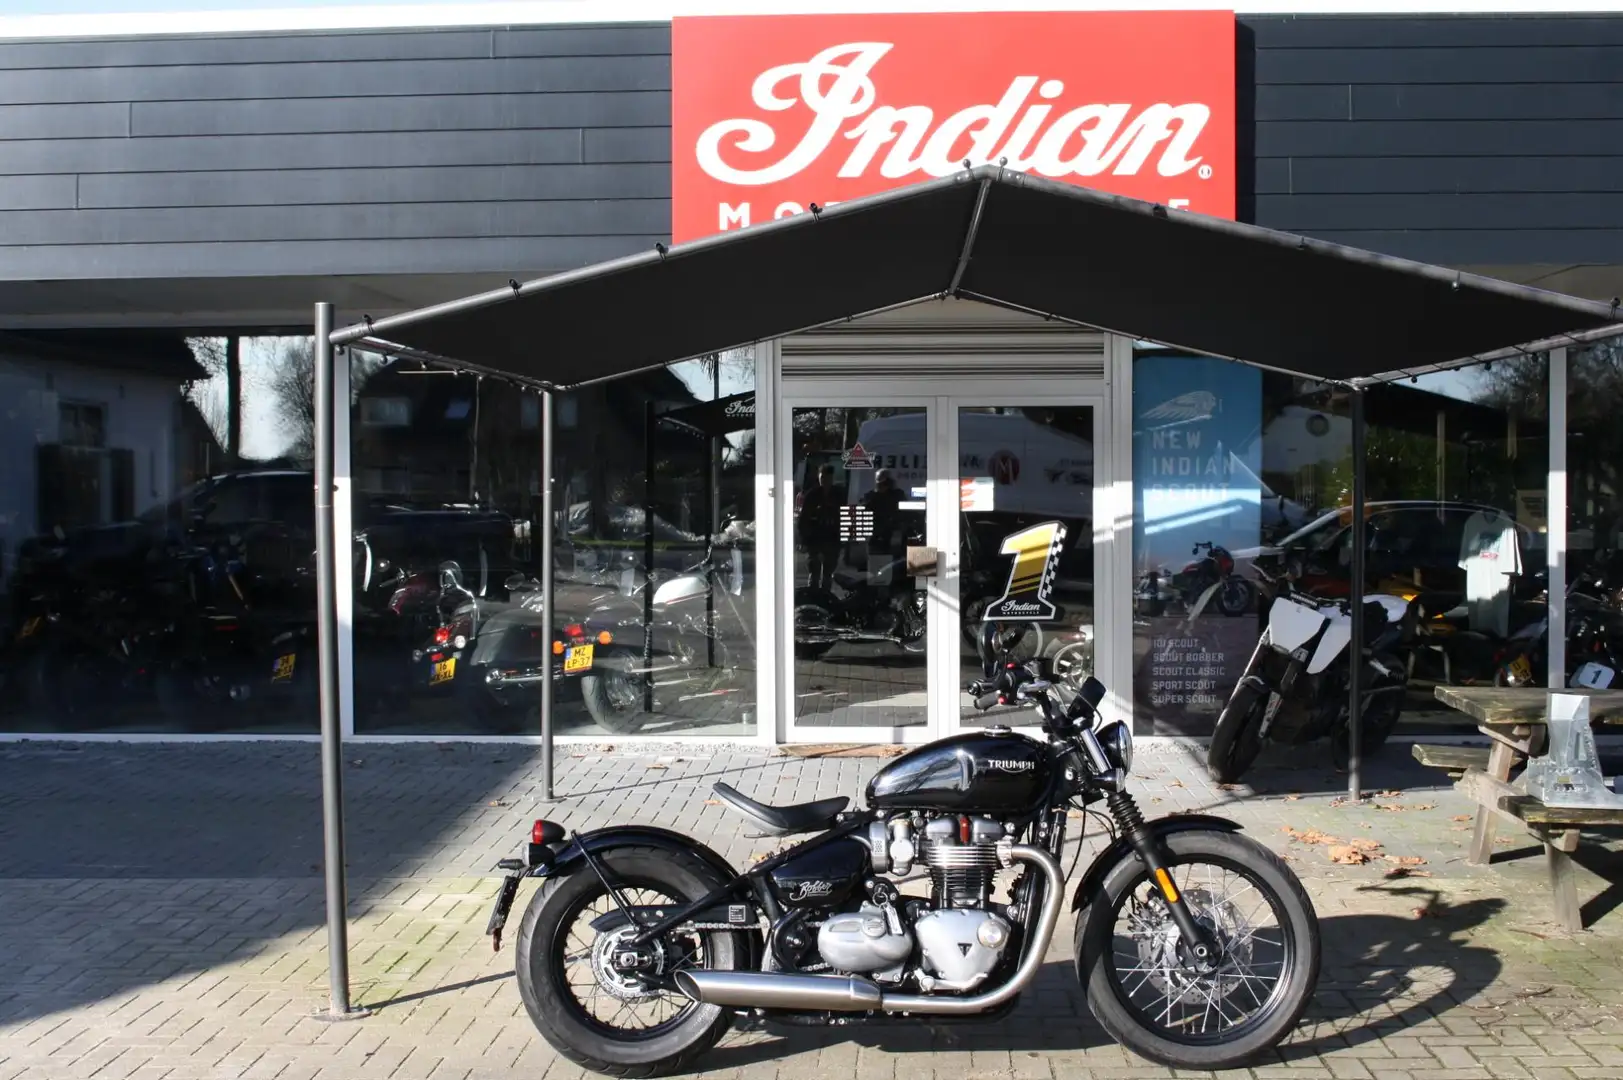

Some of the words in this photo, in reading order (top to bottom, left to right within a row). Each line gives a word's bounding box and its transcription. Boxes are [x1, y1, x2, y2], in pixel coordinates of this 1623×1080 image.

[696, 42, 1211, 185] Indian
[1152, 431, 1200, 449] NEW
[1152, 457, 1235, 475] INDIAN
[1001, 600, 1040, 612] Indian
[1168, 638, 1198, 648] SCOUT
[1153, 653, 1183, 662] SCOUT
[1186, 652, 1224, 662] BOBBER
[1152, 667, 1183, 676] SCOUT
[1185, 667, 1226, 676] CLASSIC
[1152, 681, 1183, 690] SPORT
[1185, 681, 1216, 690] SCOUT
[1152, 695, 1183, 704] SUPER
[1185, 695, 1216, 704] SCOUT
[988, 759, 1035, 772] TRIUMPH
[789, 880, 833, 901] Bobber
